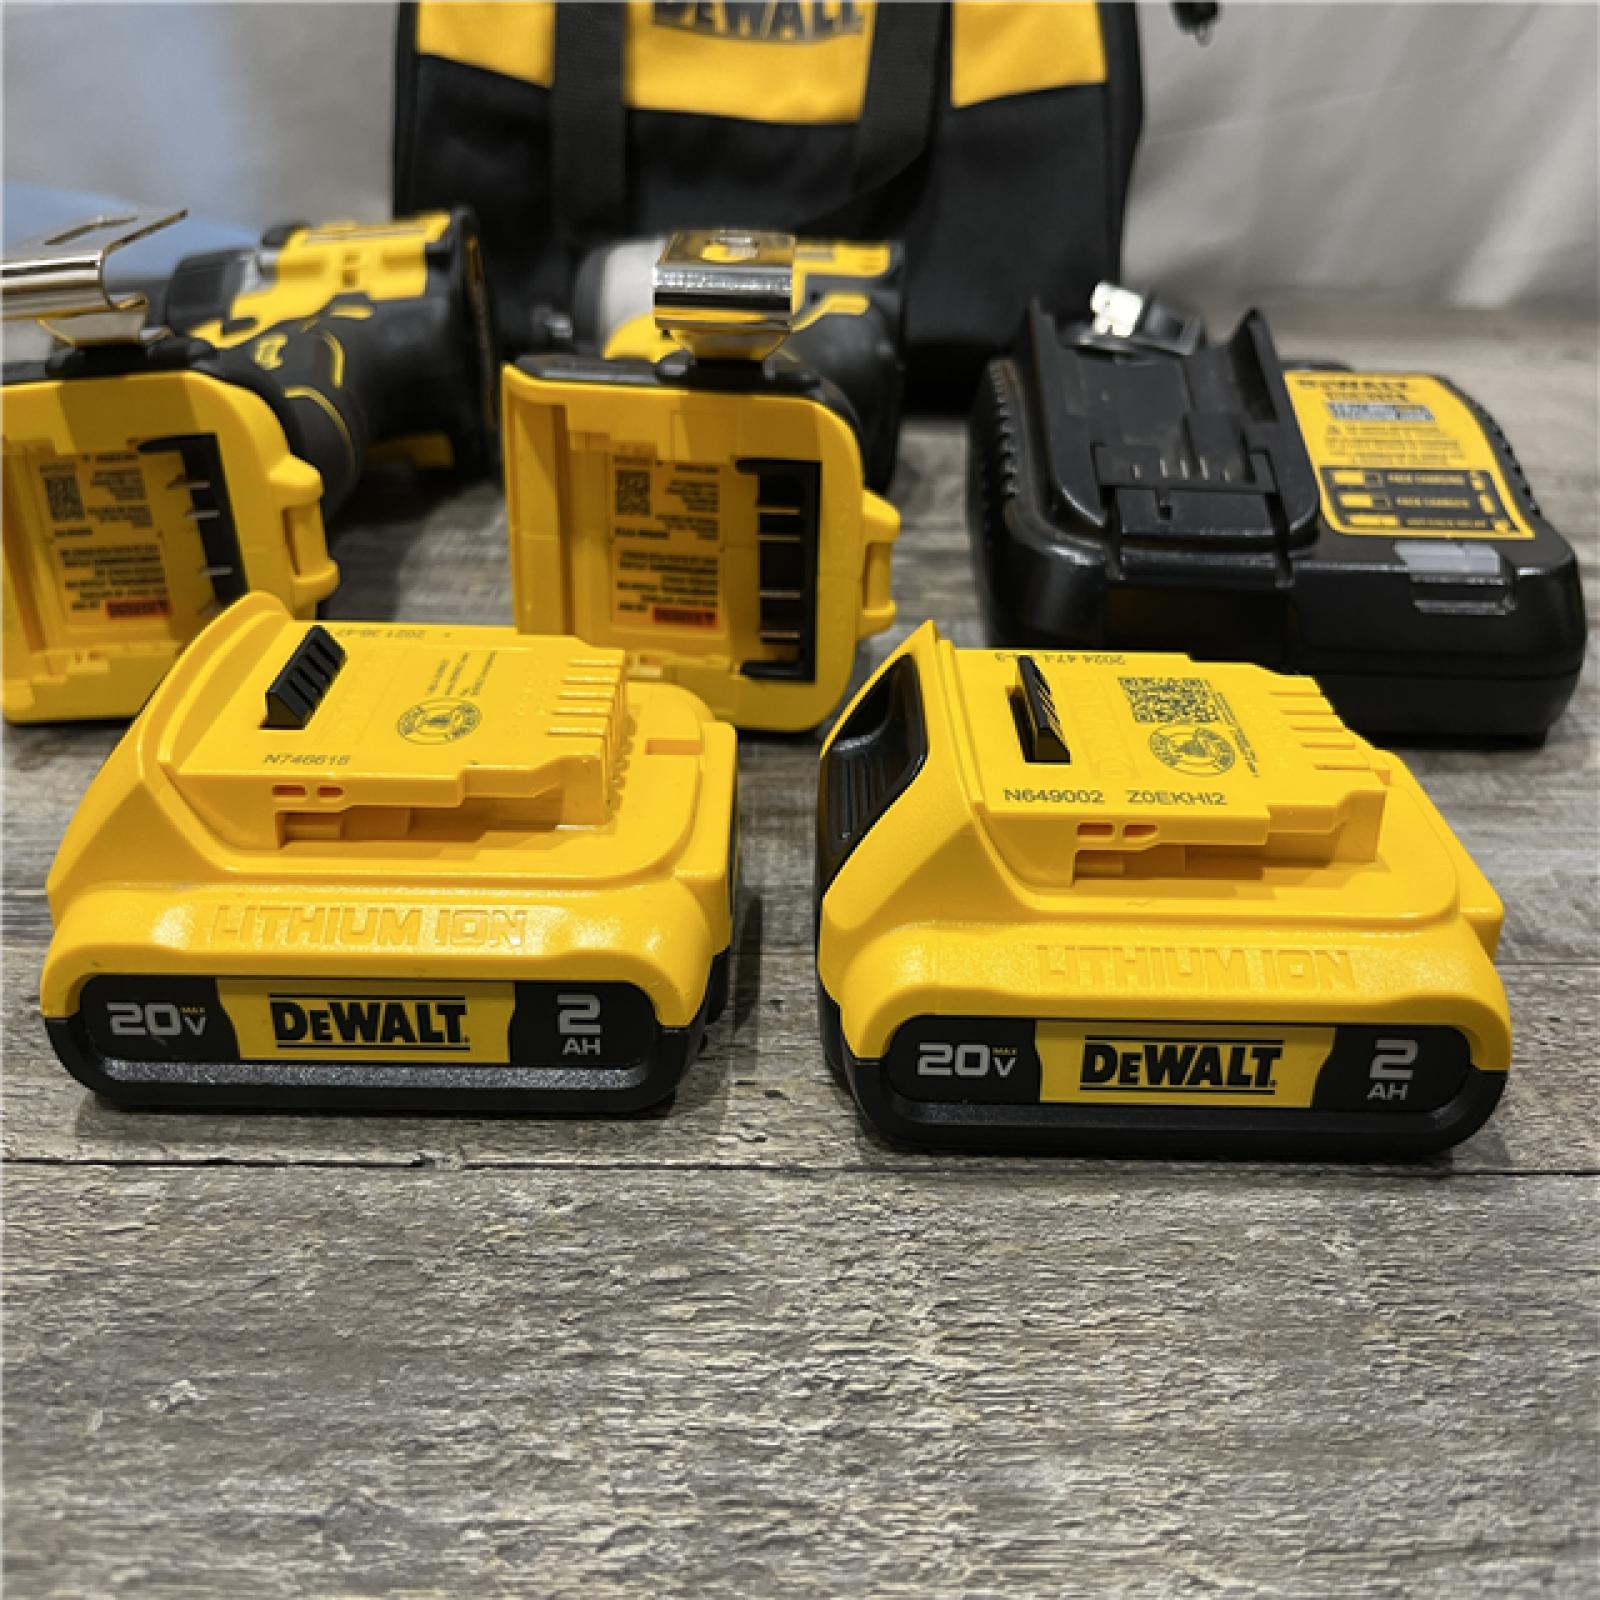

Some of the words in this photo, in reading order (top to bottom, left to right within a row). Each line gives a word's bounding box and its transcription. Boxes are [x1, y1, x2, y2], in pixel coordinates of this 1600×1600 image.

[1003, 788, 1106, 806] N649002
[210, 904, 424, 947] LITHIUM
[434, 908, 529, 948] ION
[1037, 945, 1248, 989] LITHIUM
[1260, 950, 1355, 991] ION
[557, 994, 601, 1035] 2
[562, 1037, 601, 1056] AH
[1369, 1039, 1418, 1081] 2
[1366, 1081, 1409, 1101] AH
